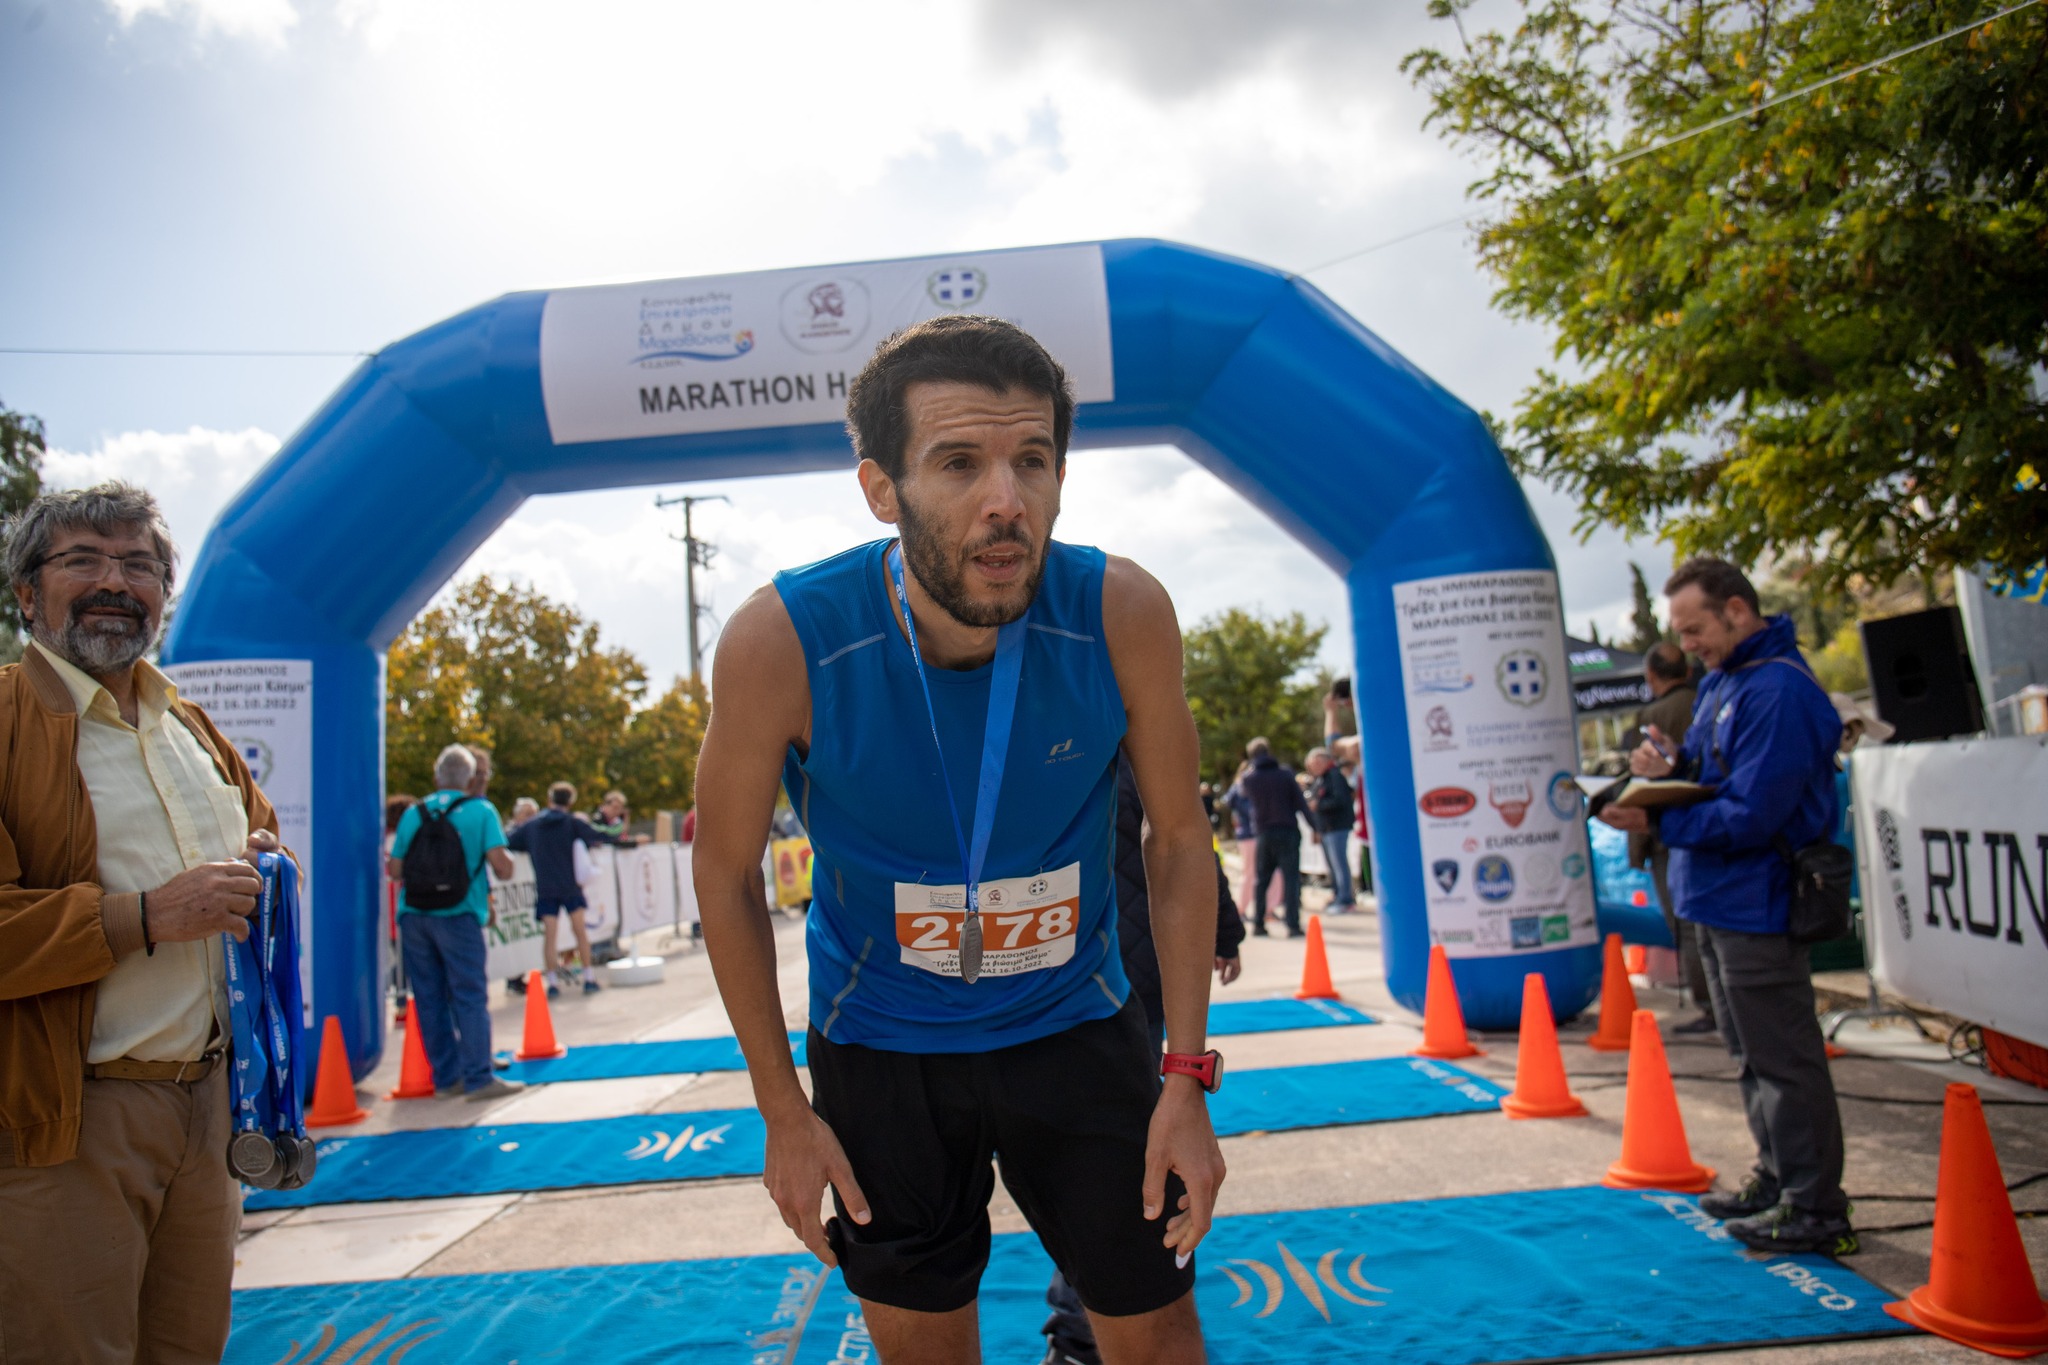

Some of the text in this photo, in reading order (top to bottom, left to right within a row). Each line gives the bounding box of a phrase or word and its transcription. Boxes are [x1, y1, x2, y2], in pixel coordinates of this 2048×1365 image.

[639, 374, 815, 414] MARATHON
[1485, 831, 1561, 850] EUROBANK
[1920, 827, 2048, 950] RUN
[983, 948, 1038, 959] ΜΑΡΑΘΩΝΙΟΣ
[993, 959, 1023, 968] βιώσιμο
[1000, 961, 1042, 974] 16.10.2022
